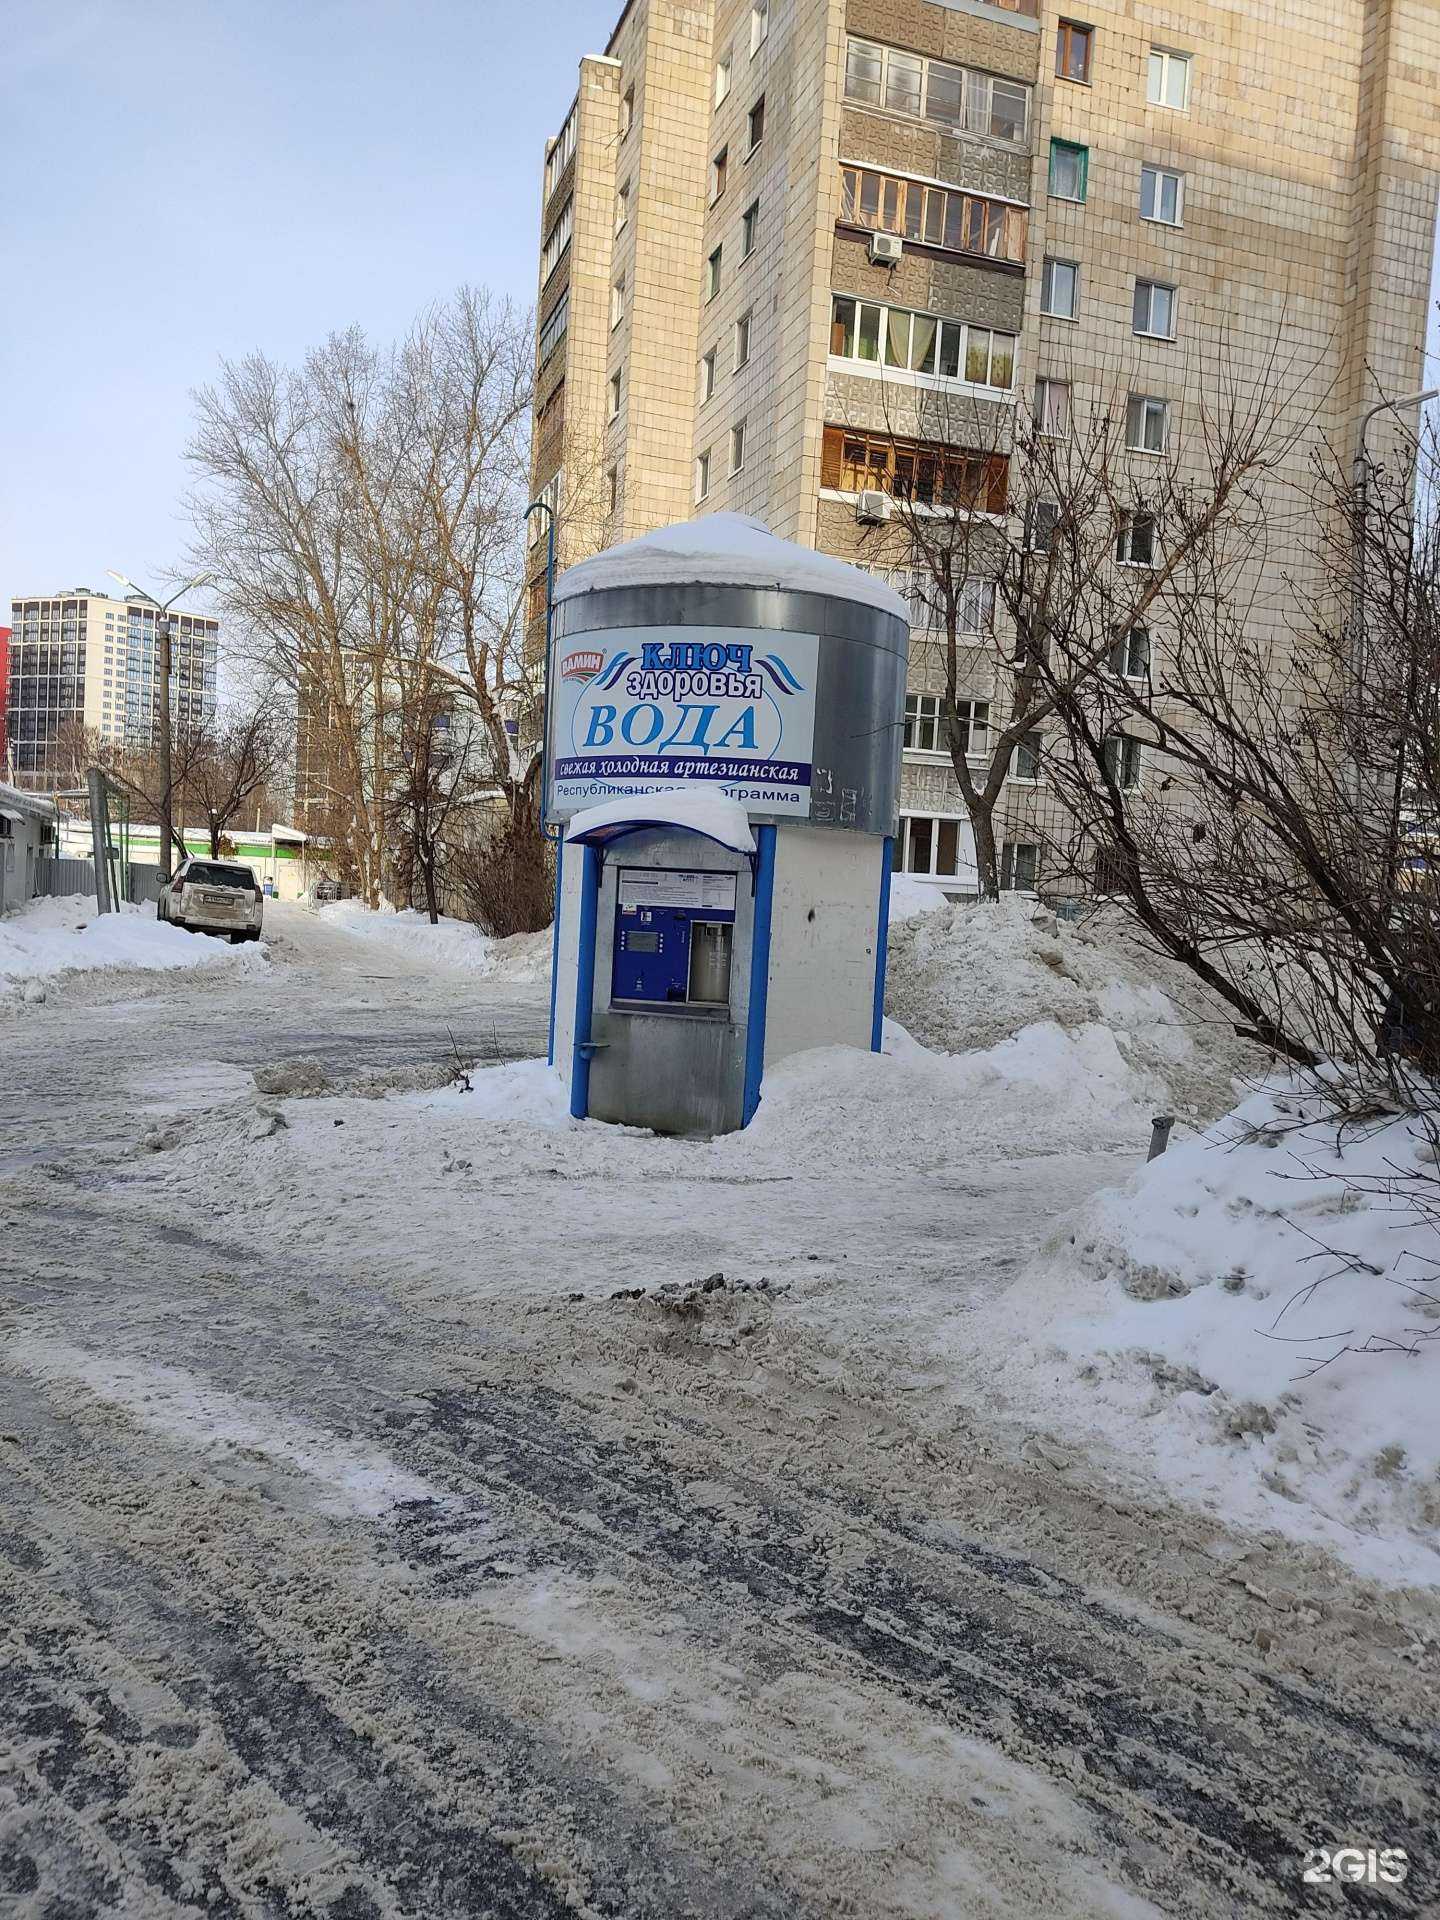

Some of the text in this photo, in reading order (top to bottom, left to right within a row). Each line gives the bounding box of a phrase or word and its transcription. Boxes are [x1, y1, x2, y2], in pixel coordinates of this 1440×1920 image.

[641, 643, 753, 673] КЛЮЧ
[582, 703, 758, 756] ВОДА
[560, 755, 799, 781] свежая холодная артезианская
